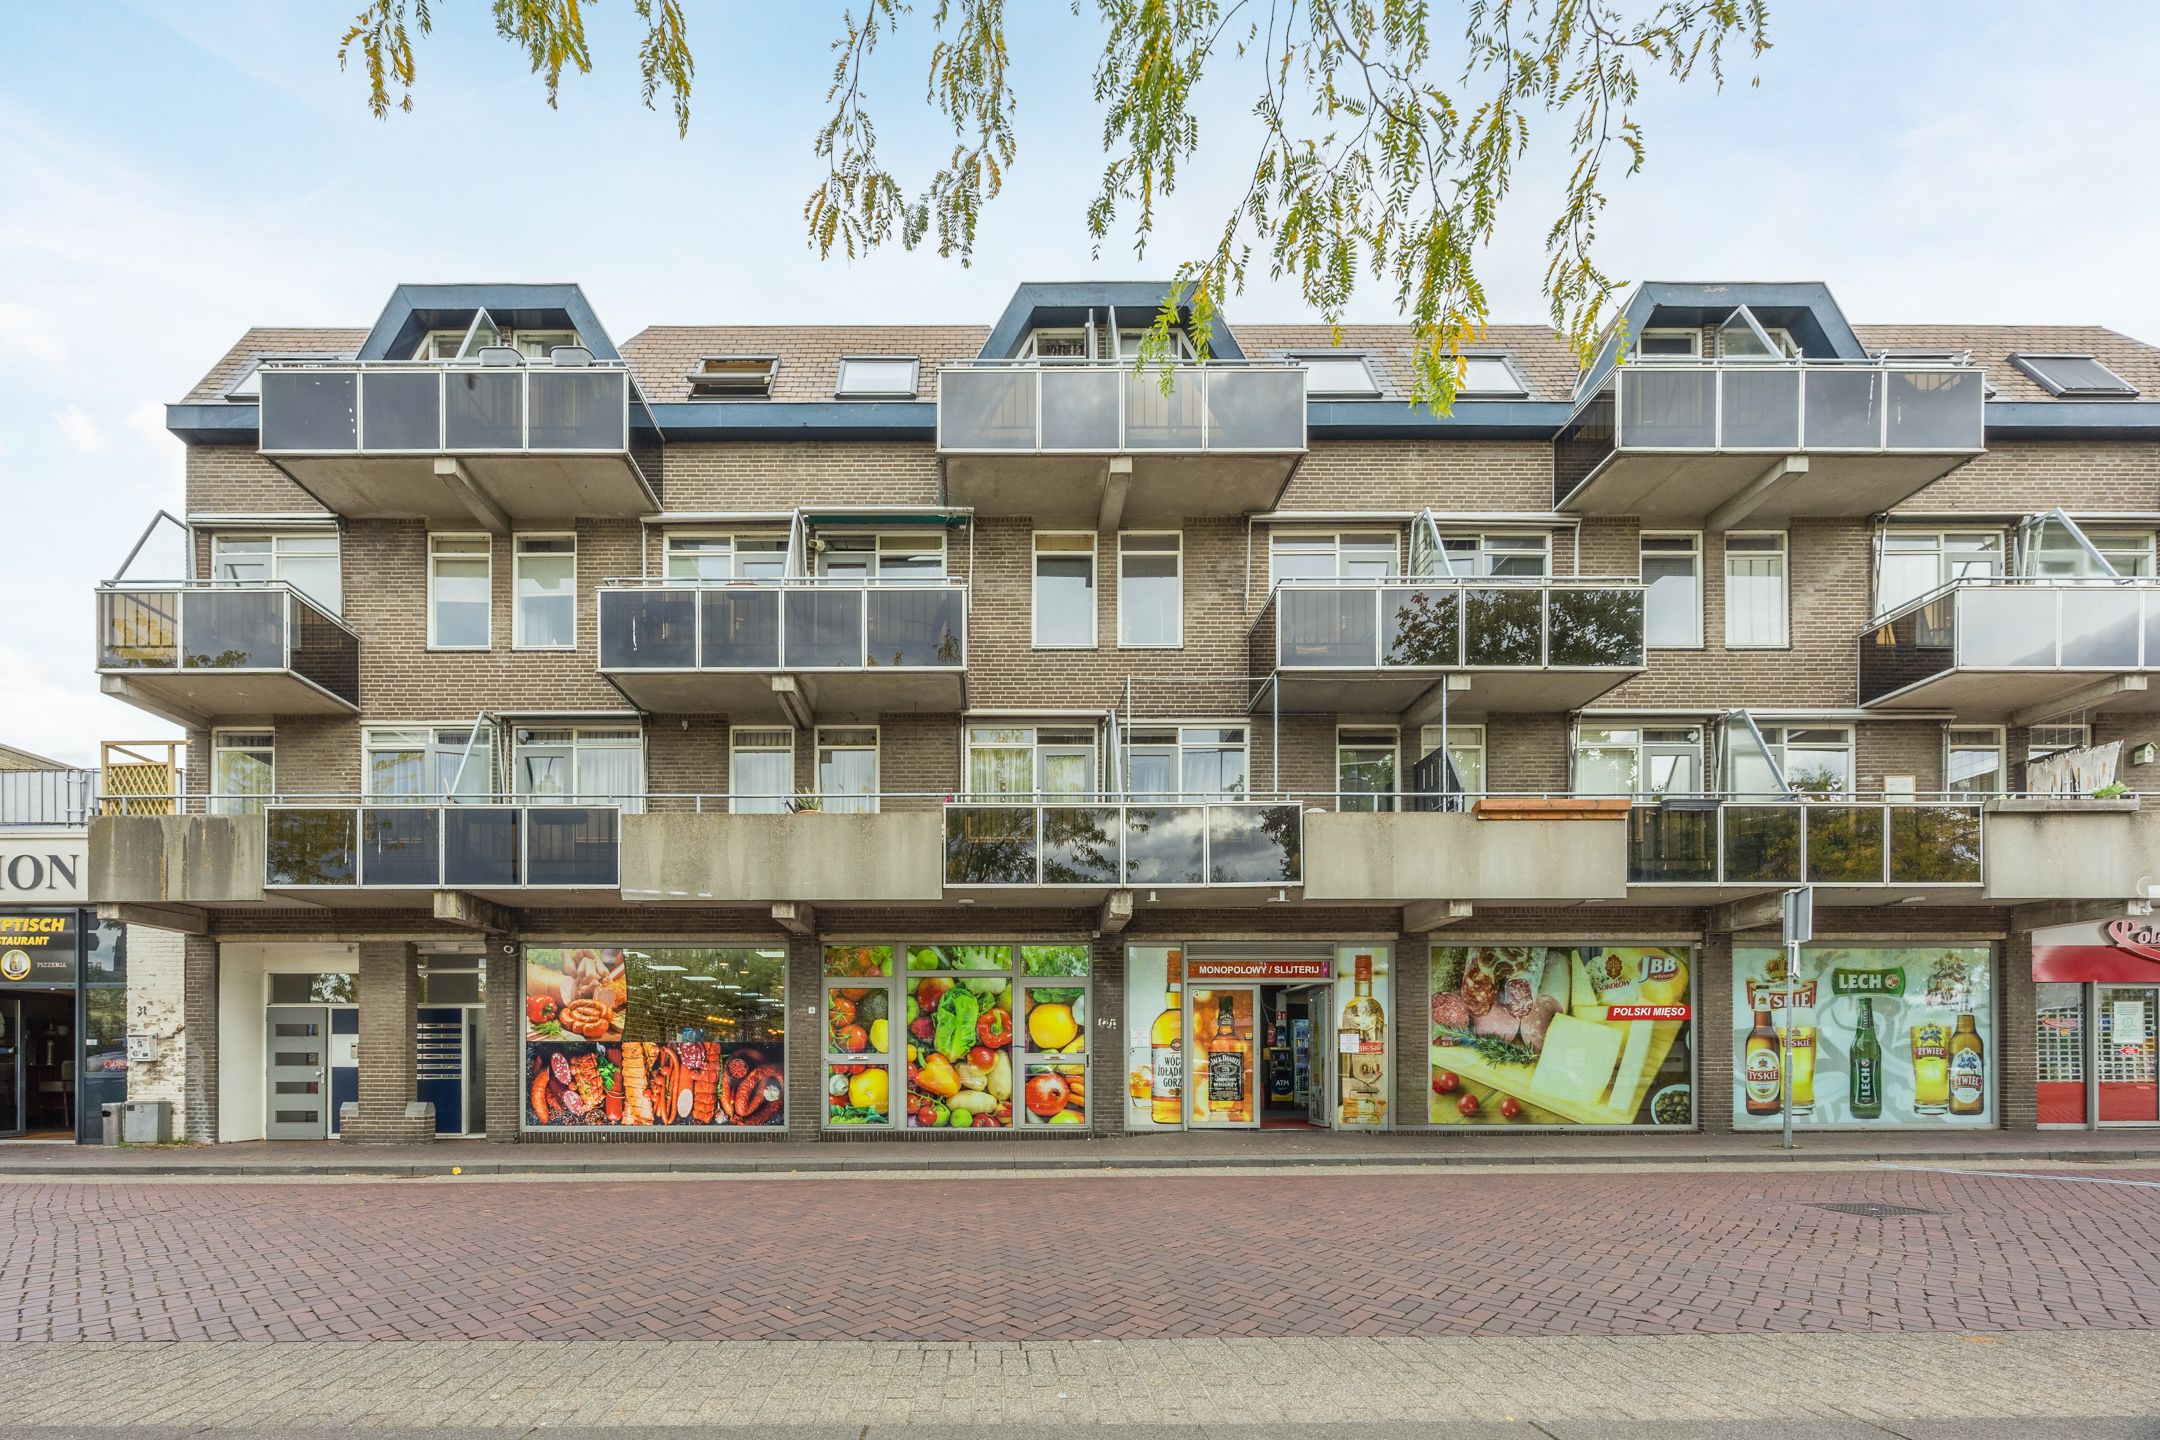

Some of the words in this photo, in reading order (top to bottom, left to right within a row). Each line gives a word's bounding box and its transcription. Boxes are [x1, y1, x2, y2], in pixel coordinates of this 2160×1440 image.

[1199, 963, 1266, 974] MONOPOLOWY
[1274, 964, 1320, 974] SLIJTERIJ
[1638, 955, 1677, 984] JBB
[1838, 974, 1882, 989] LECH
[1613, 1007, 1651, 1016] POLSKI
[1653, 1007, 1686, 1018] MIĘSO
[1783, 1038, 1811, 1047] TSKIE
[1749, 1070, 1778, 1080] TYSKIE
[1861, 1067, 1871, 1096] LECH
